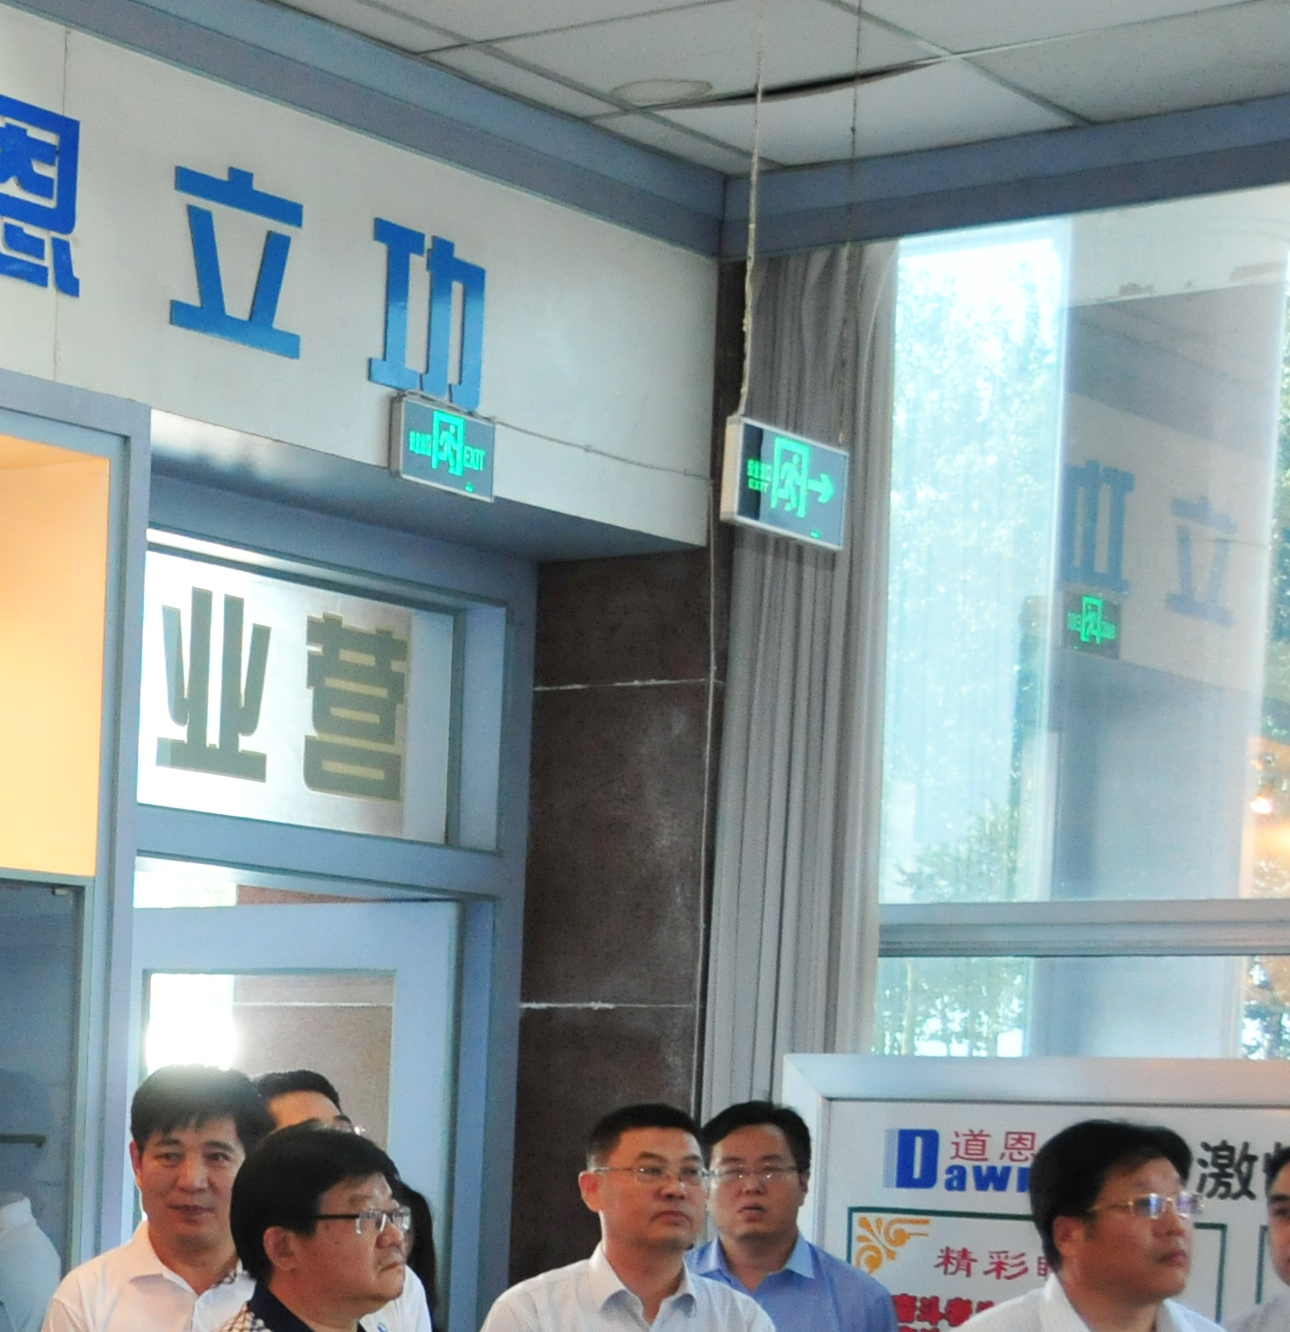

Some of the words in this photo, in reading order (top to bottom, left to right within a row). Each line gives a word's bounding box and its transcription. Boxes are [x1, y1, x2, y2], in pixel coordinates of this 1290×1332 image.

[464, 445, 486, 471] EXIT
[1197, 1140, 1285, 1200] 激
[933, 1246, 1052, 1280] 精彩
